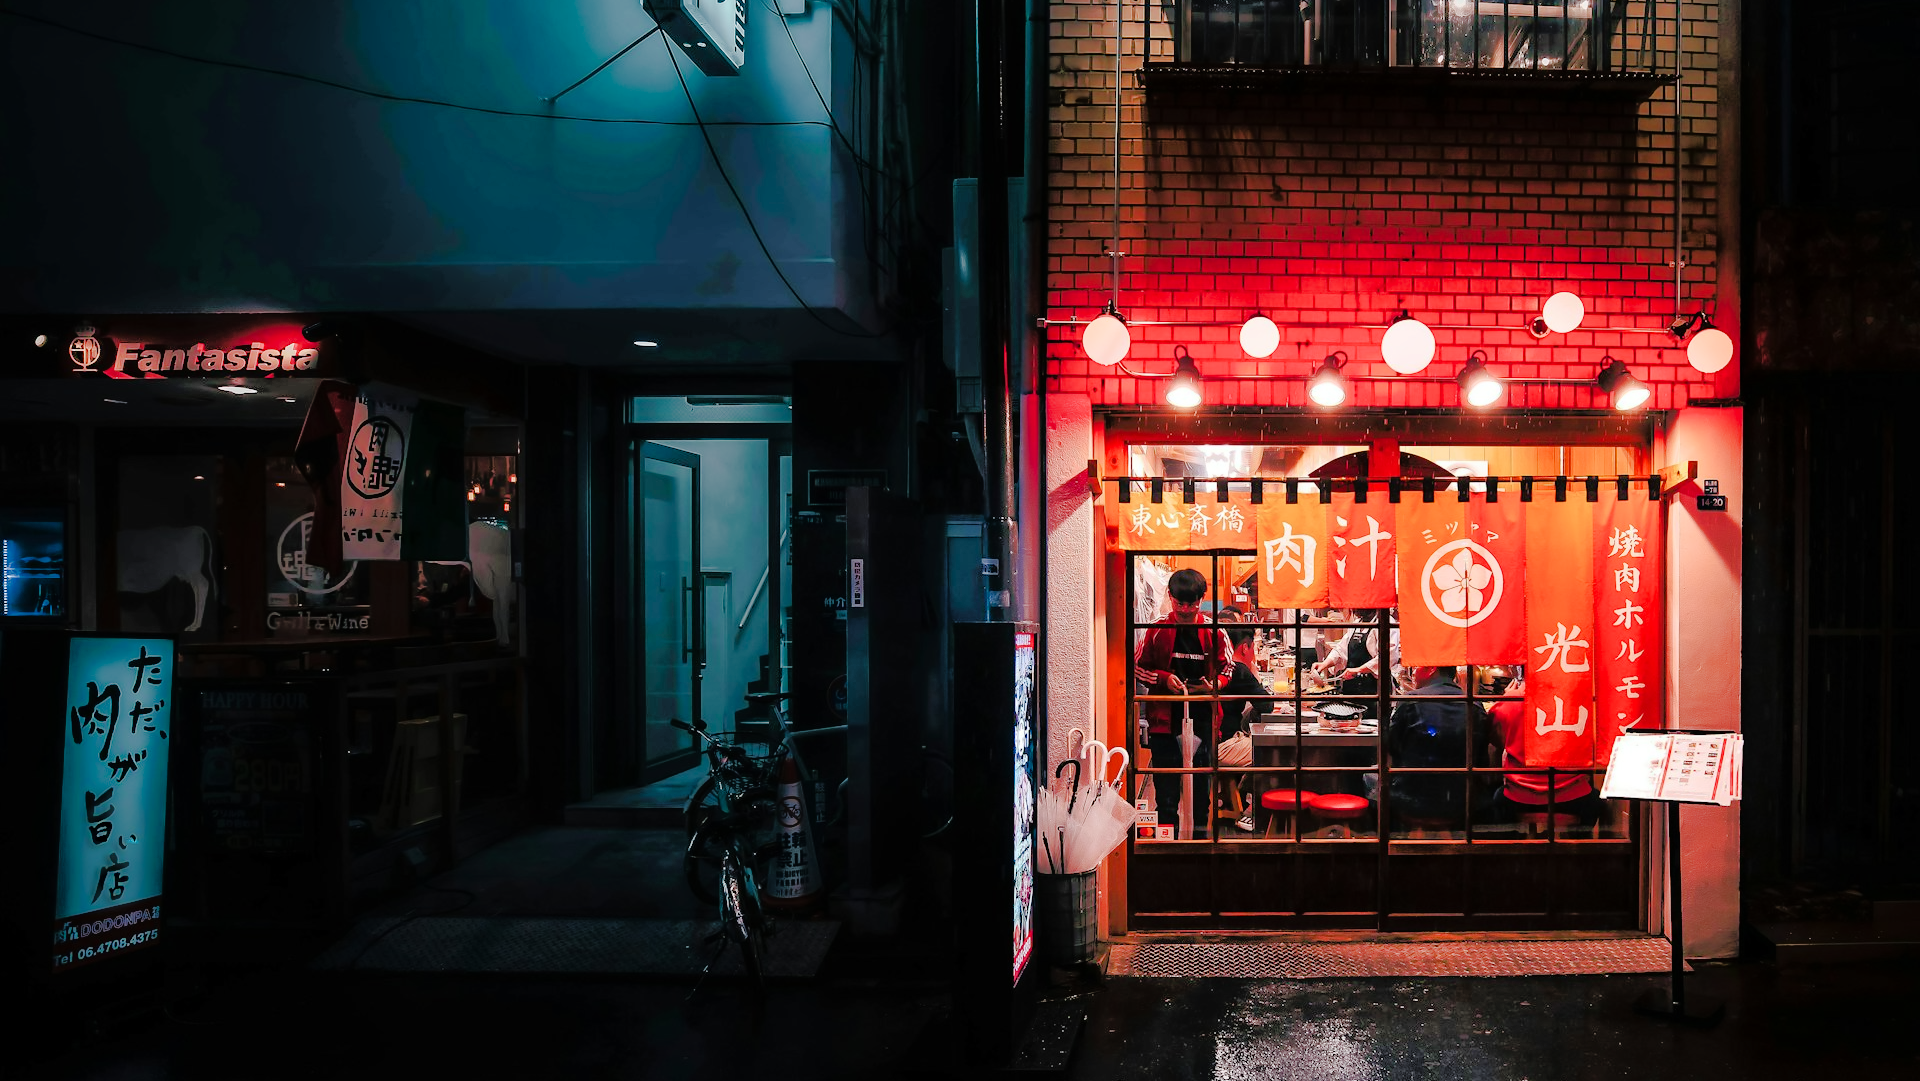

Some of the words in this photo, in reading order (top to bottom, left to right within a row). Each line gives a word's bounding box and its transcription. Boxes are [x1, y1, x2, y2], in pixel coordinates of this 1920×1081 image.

[114, 342, 319, 372] Fantasista
[1701, 498, 1724, 507] 14-20
[1129, 503, 1245, 536] 東心斎橋
[1264, 515, 1392, 588] 肉汁
[1607, 524, 1646, 735] 焼肉ホルモン
[1534, 622, 1590, 736] 光山
[202, 692, 256, 709] HAPPY
[259, 692, 309, 709] HOUR
[80, 908, 151, 938] DODONPA
[54, 951, 73, 967] Tel
[77, 929, 159, 959] 06.4708.4375
